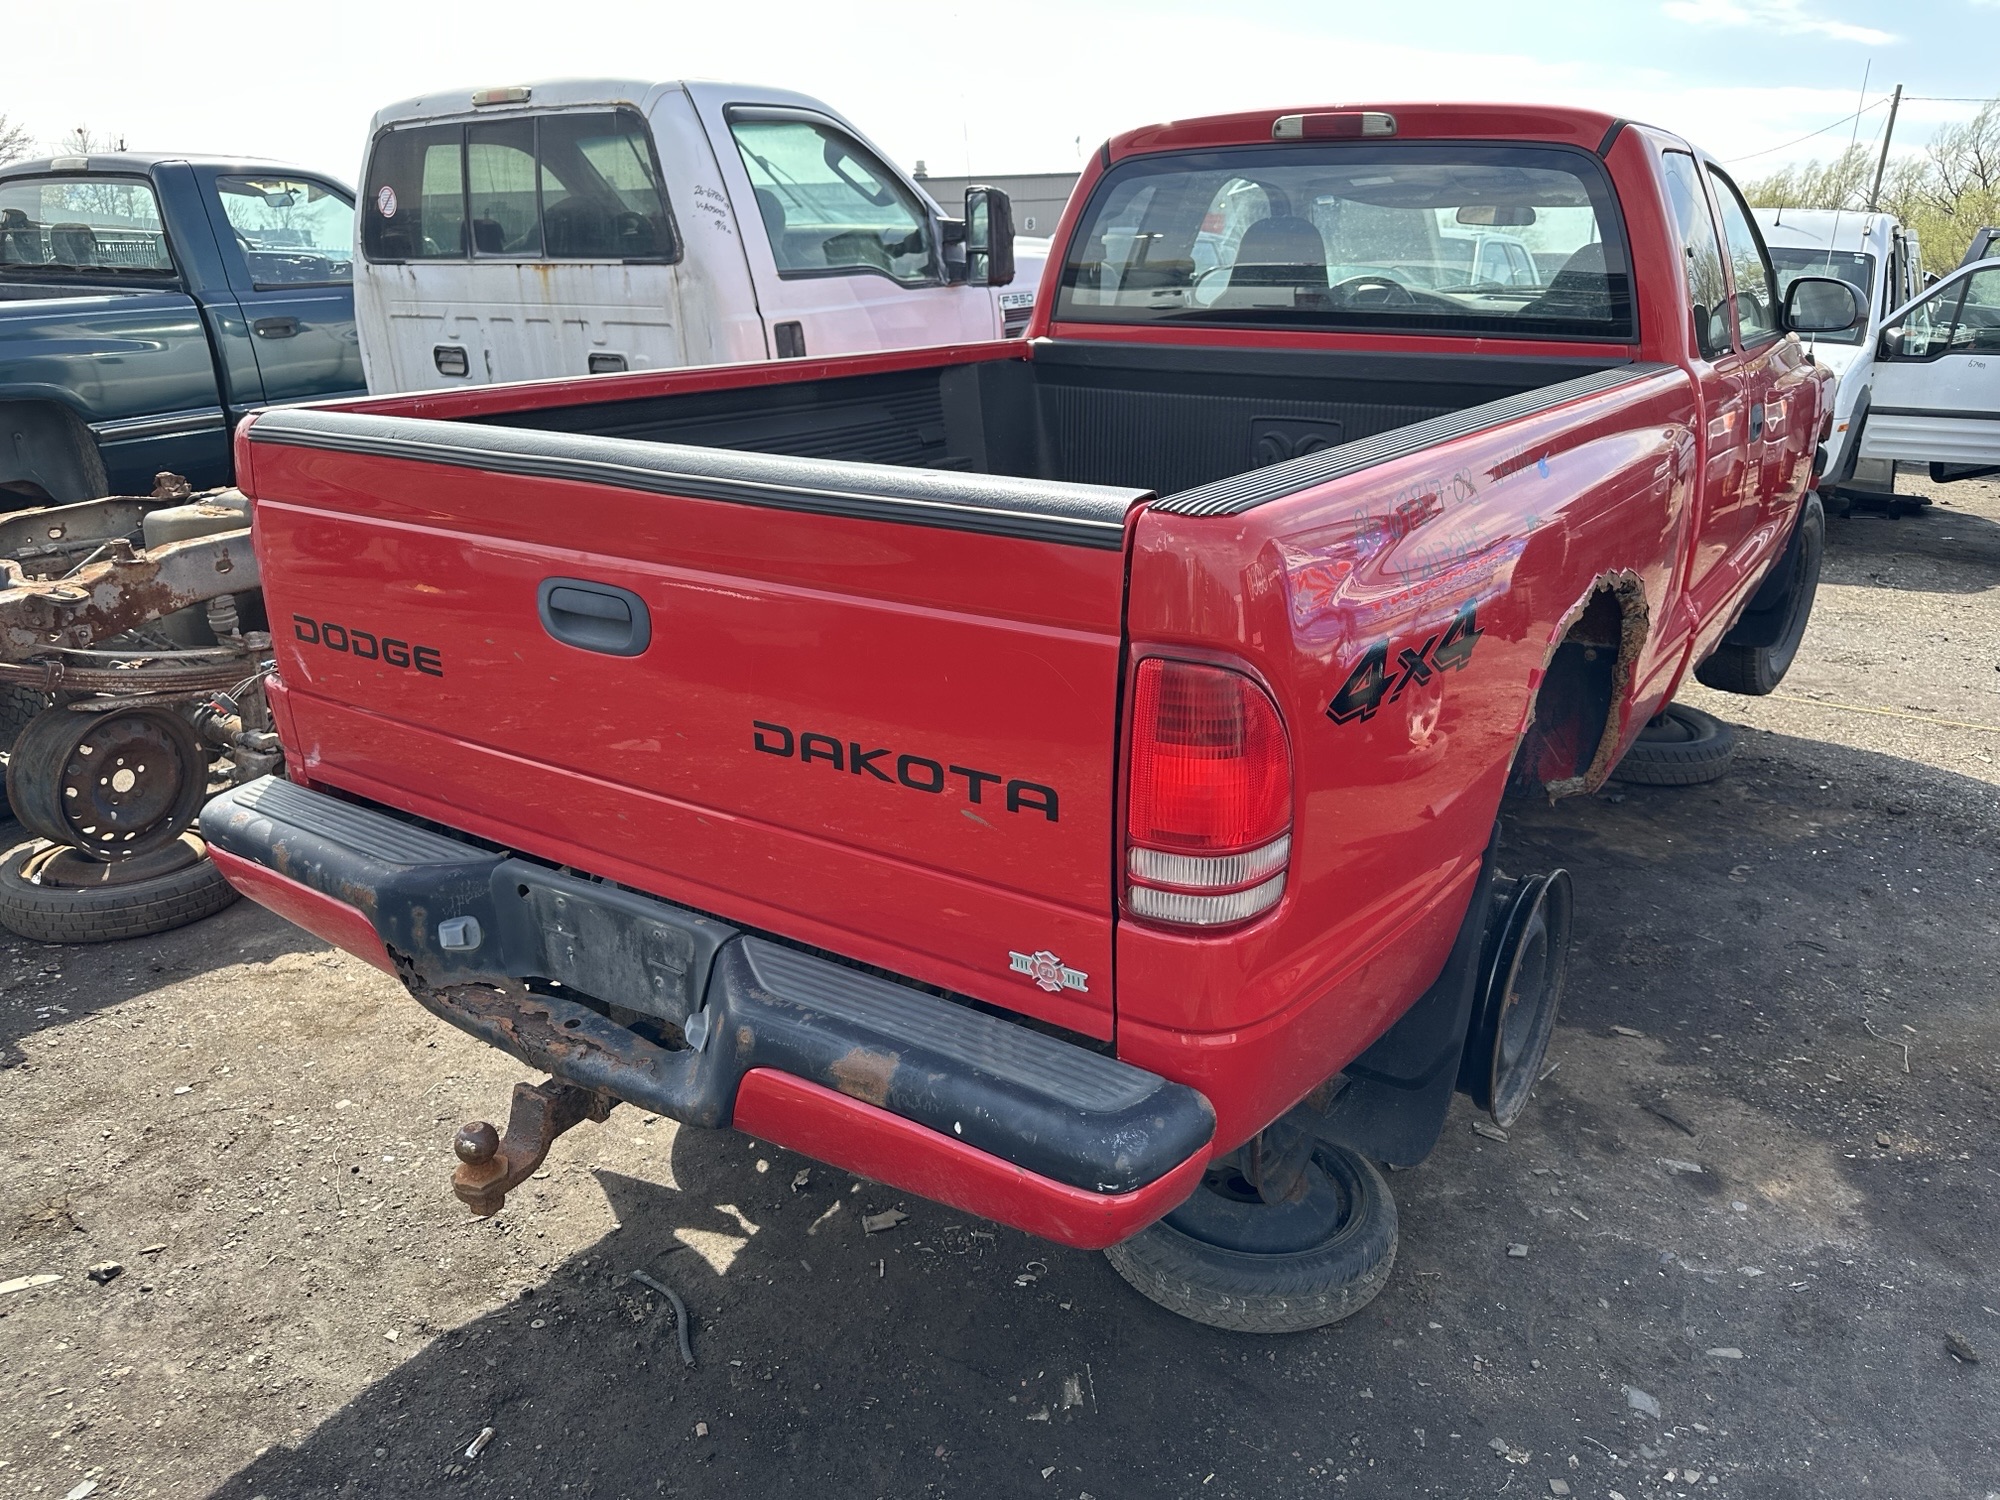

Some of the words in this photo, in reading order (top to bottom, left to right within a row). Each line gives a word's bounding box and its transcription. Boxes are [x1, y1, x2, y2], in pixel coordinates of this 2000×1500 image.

[1001, 293, 1034, 306] F-350
[293, 613, 443, 677] DODGE
[753, 719, 1059, 823] DAKOTA
